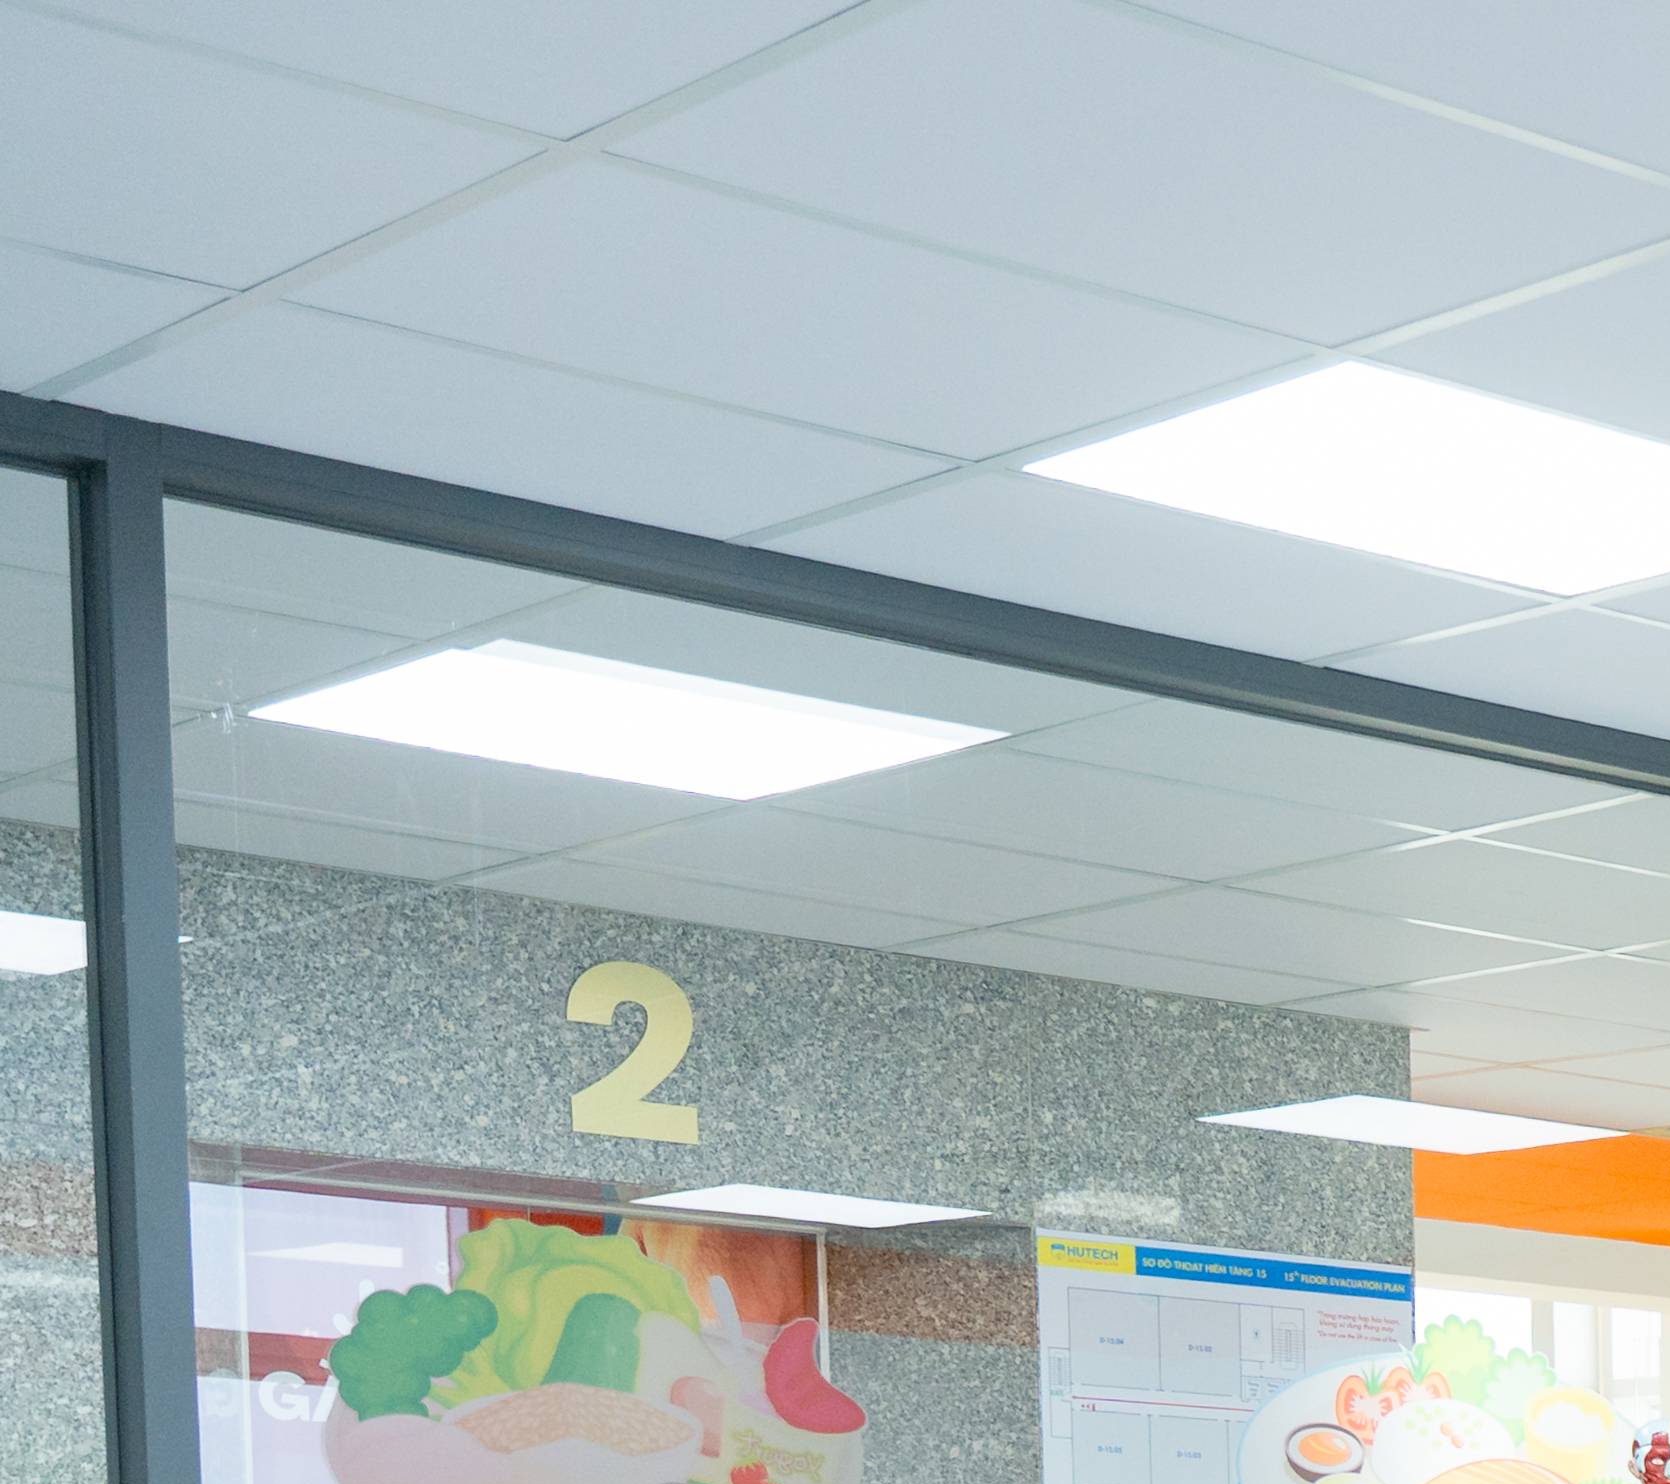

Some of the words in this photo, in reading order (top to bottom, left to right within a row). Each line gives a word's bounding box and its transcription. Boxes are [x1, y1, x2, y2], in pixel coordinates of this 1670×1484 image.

[566, 960, 699, 1144] 2
[1066, 1246, 1119, 1262] HUTECH
[1256, 1269, 1268, 1279] 15
[1300, 1274, 1329, 1286] FLOOR
[1330, 1277, 1383, 1291] EVACUATION
[1384, 1281, 1406, 1293] PLAN
